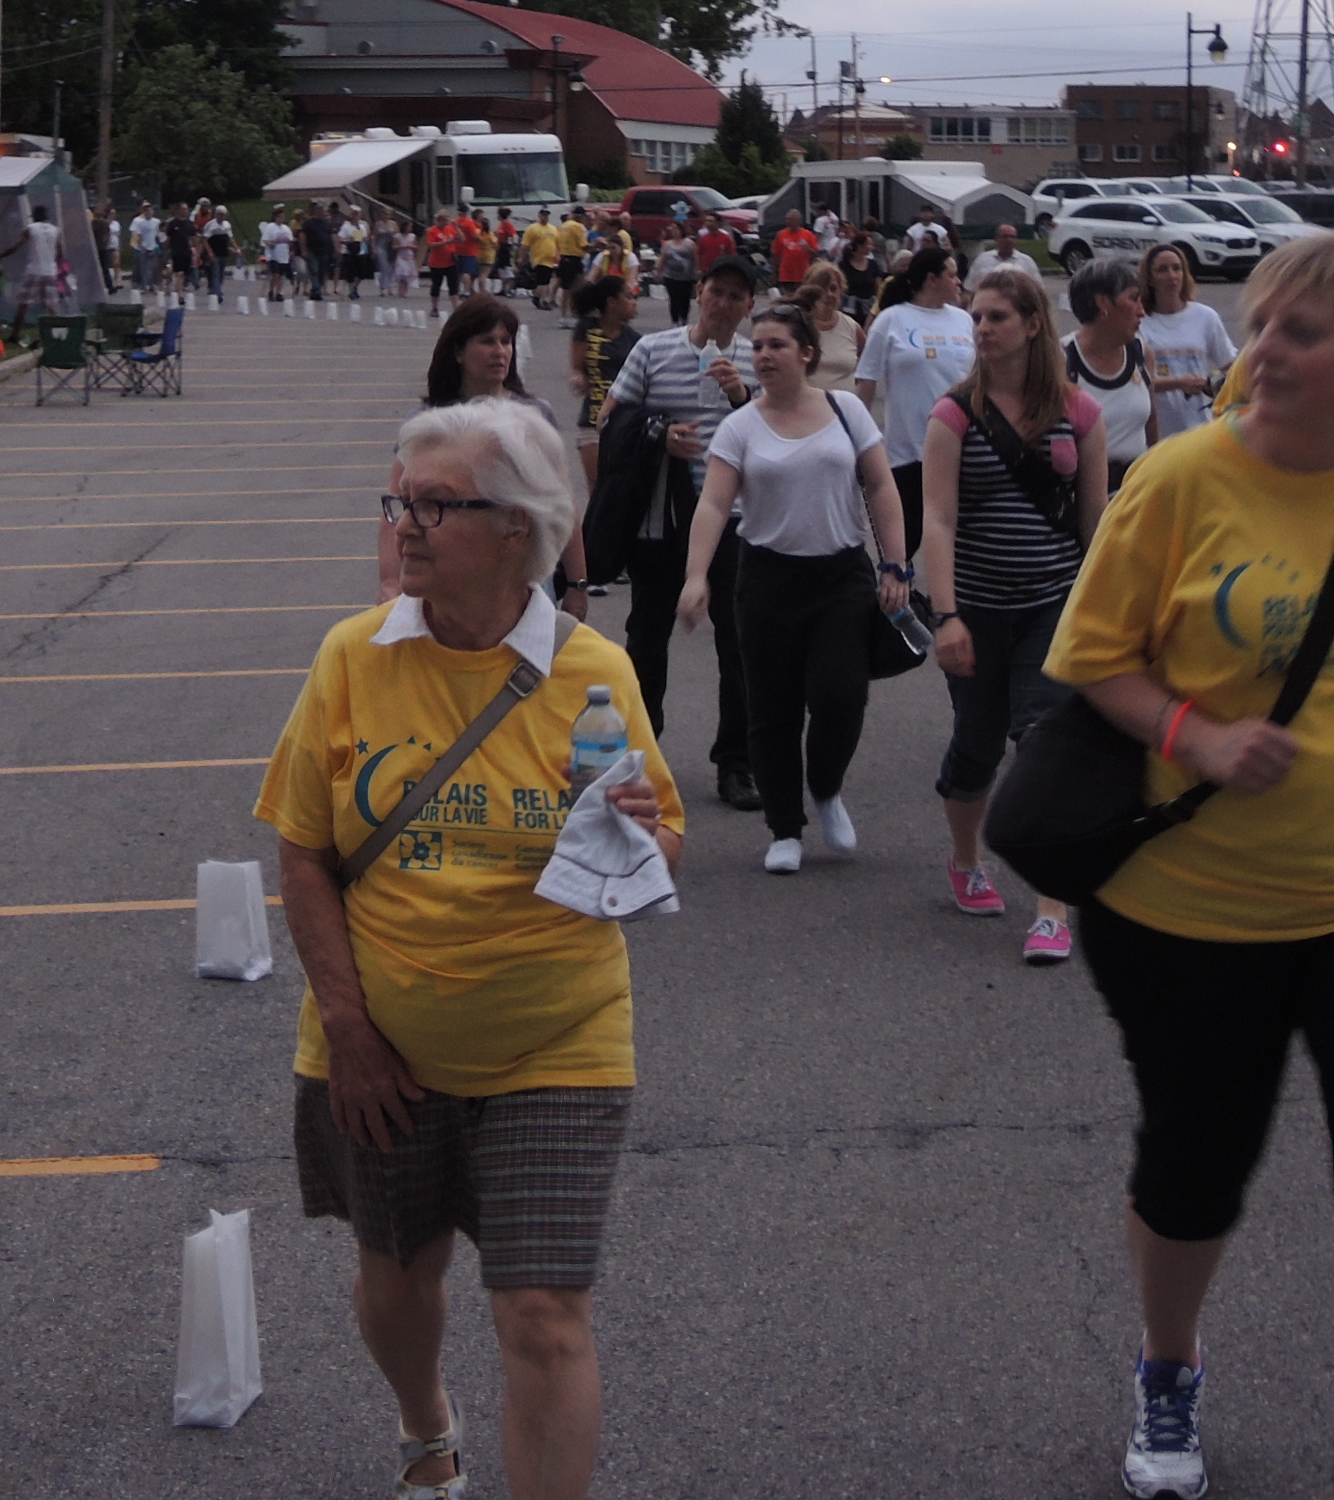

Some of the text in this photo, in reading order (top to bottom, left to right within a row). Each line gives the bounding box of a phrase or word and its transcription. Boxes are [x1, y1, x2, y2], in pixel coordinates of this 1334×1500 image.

[403, 781, 488, 806] RLAIS
[512, 788, 572, 812] RELA
[411, 806, 488, 826] OUR LA VIE
[514, 811, 550, 830] FOR
